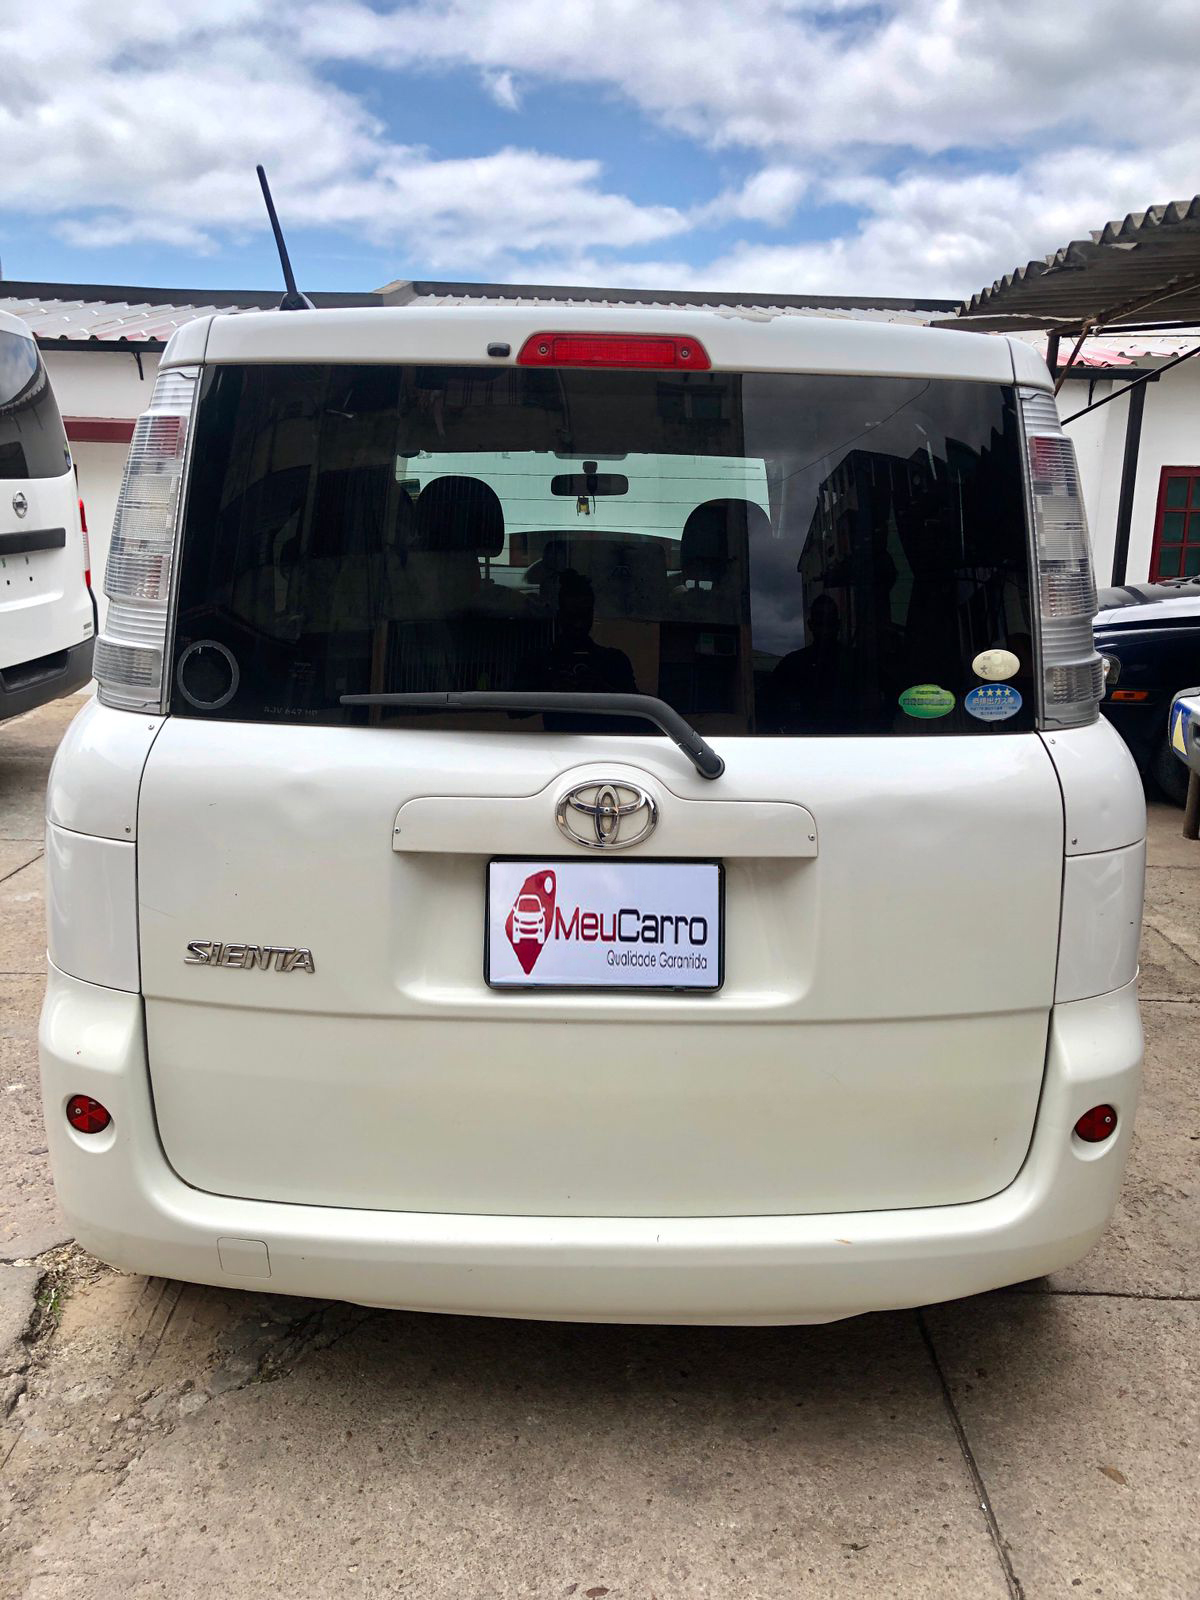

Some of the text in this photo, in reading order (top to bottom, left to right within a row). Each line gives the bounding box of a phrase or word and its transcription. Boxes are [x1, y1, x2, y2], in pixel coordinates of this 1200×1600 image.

[555, 906, 708, 946] MeuCarro
[184, 940, 316, 973] SIENTA
[606, 949, 707, 970] Qualidade Garantida
